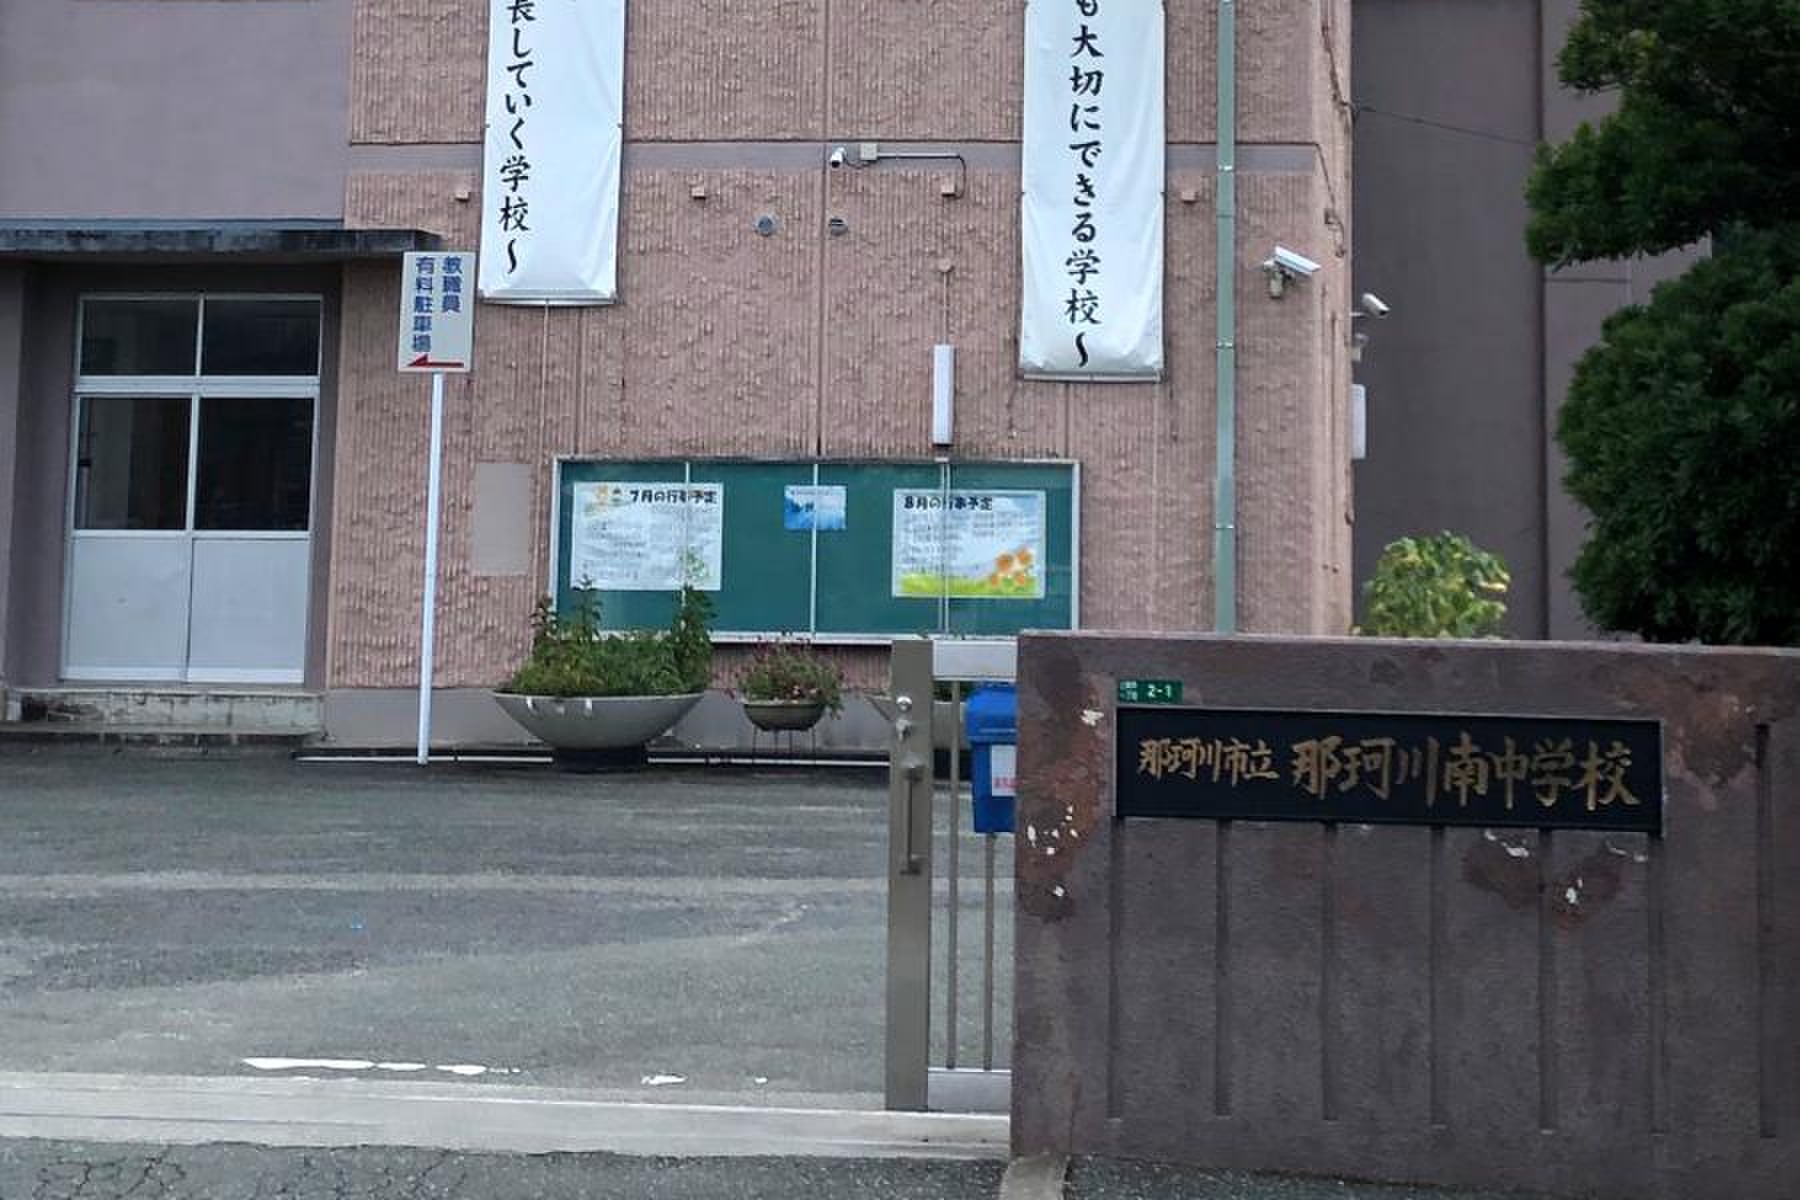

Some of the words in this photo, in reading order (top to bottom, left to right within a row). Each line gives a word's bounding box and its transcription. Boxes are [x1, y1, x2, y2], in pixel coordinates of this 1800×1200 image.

[411, 256, 436, 353] 有料駐車場
[1147, 684, 1172, 699] 2-1
[1137, 737, 1280, 787] 那珂川市立
[1290, 731, 1640, 812] 那珂川南中学校
